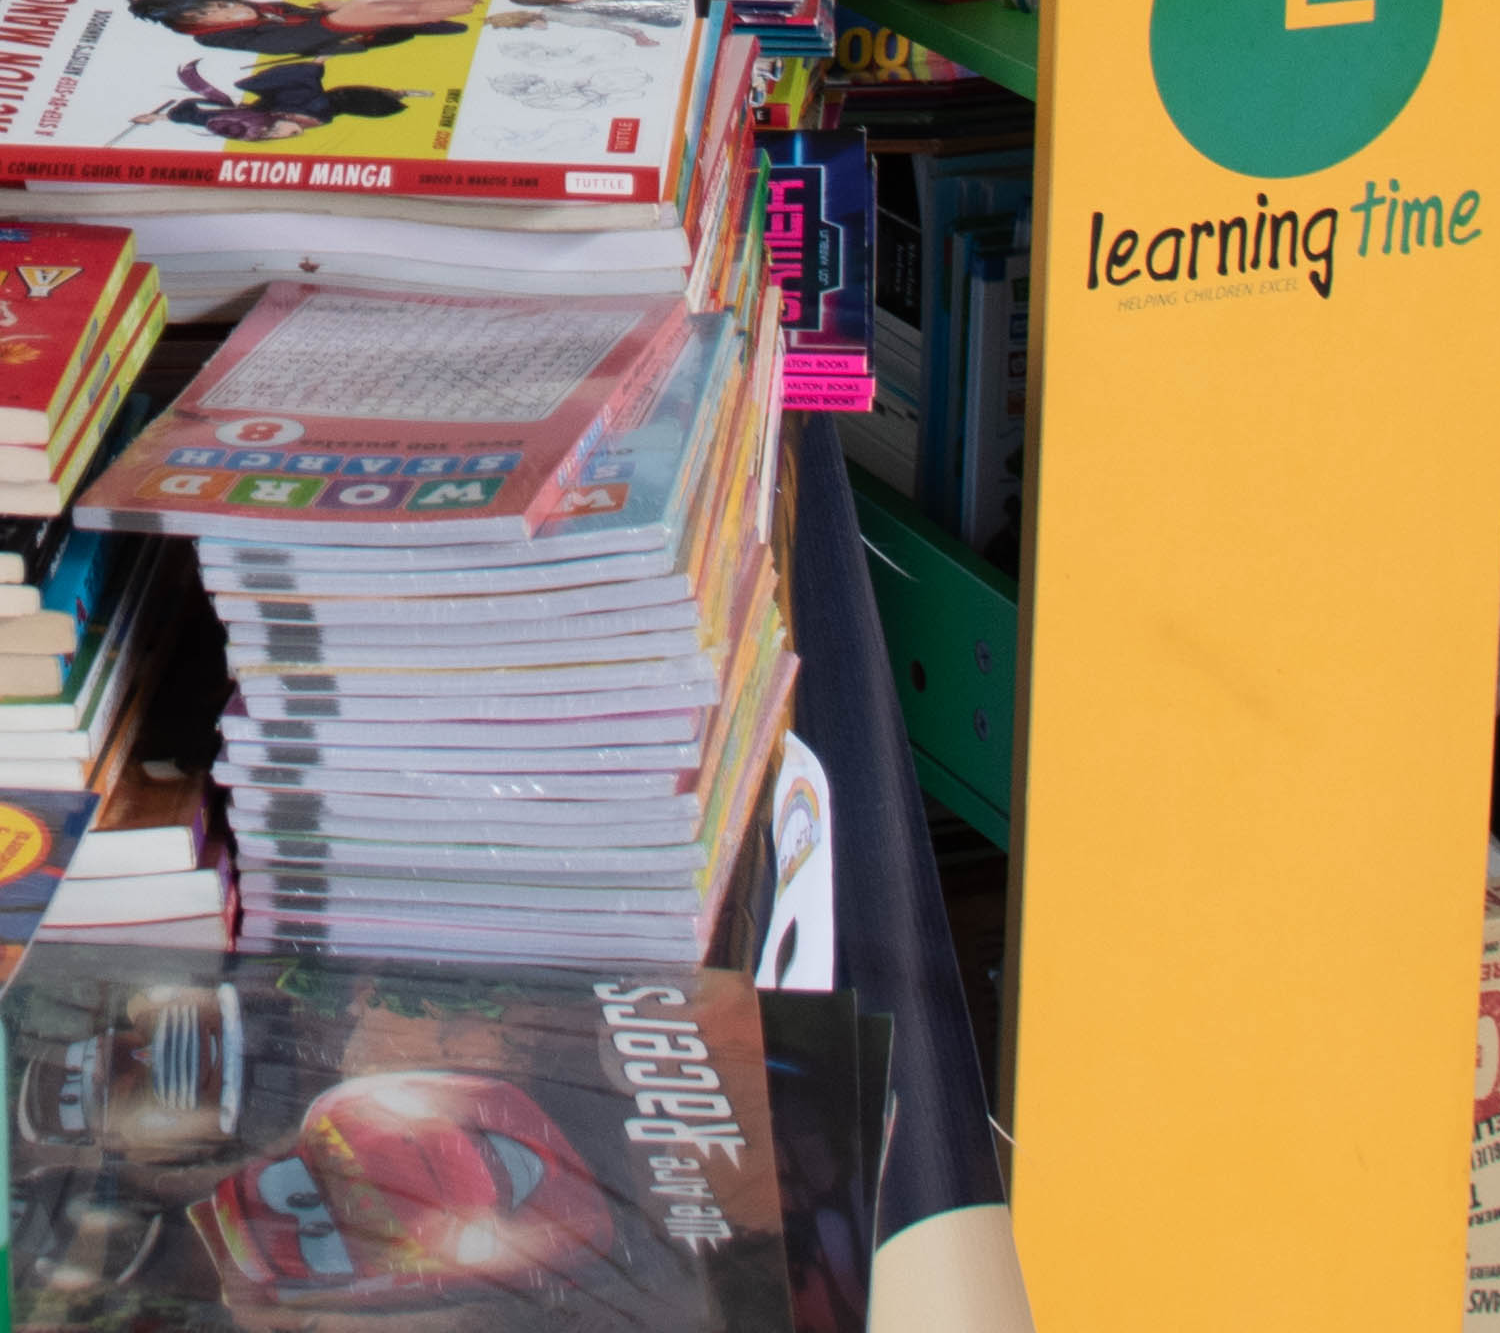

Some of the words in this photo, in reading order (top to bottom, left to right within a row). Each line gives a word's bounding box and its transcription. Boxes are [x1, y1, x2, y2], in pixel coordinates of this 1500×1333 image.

[6, 160, 76, 178] COMPLETE
[80, 163, 125, 180] GUIDE
[126, 164, 146, 180] TO
[150, 166, 216, 182] DRAWING
[217, 157, 303, 184] ACTION
[309, 161, 394, 188] MANGA
[575, 177, 625, 190] TUTTLE
[1086, 191, 1339, 300] learning
[1349, 177, 1482, 258] time
[1117, 290, 1179, 313] HELPING
[1183, 281, 1254, 304] CHILDREN
[1256, 276, 1299, 294] EXCEL
[236, 421, 284, 442] 8
[167, 449, 505, 477] SEARCH
[159, 472, 487, 508] WORD
[592, 982, 747, 1170] Racers
[648, 1156, 715, 1201] Are
[664, 1203, 733, 1256] We
